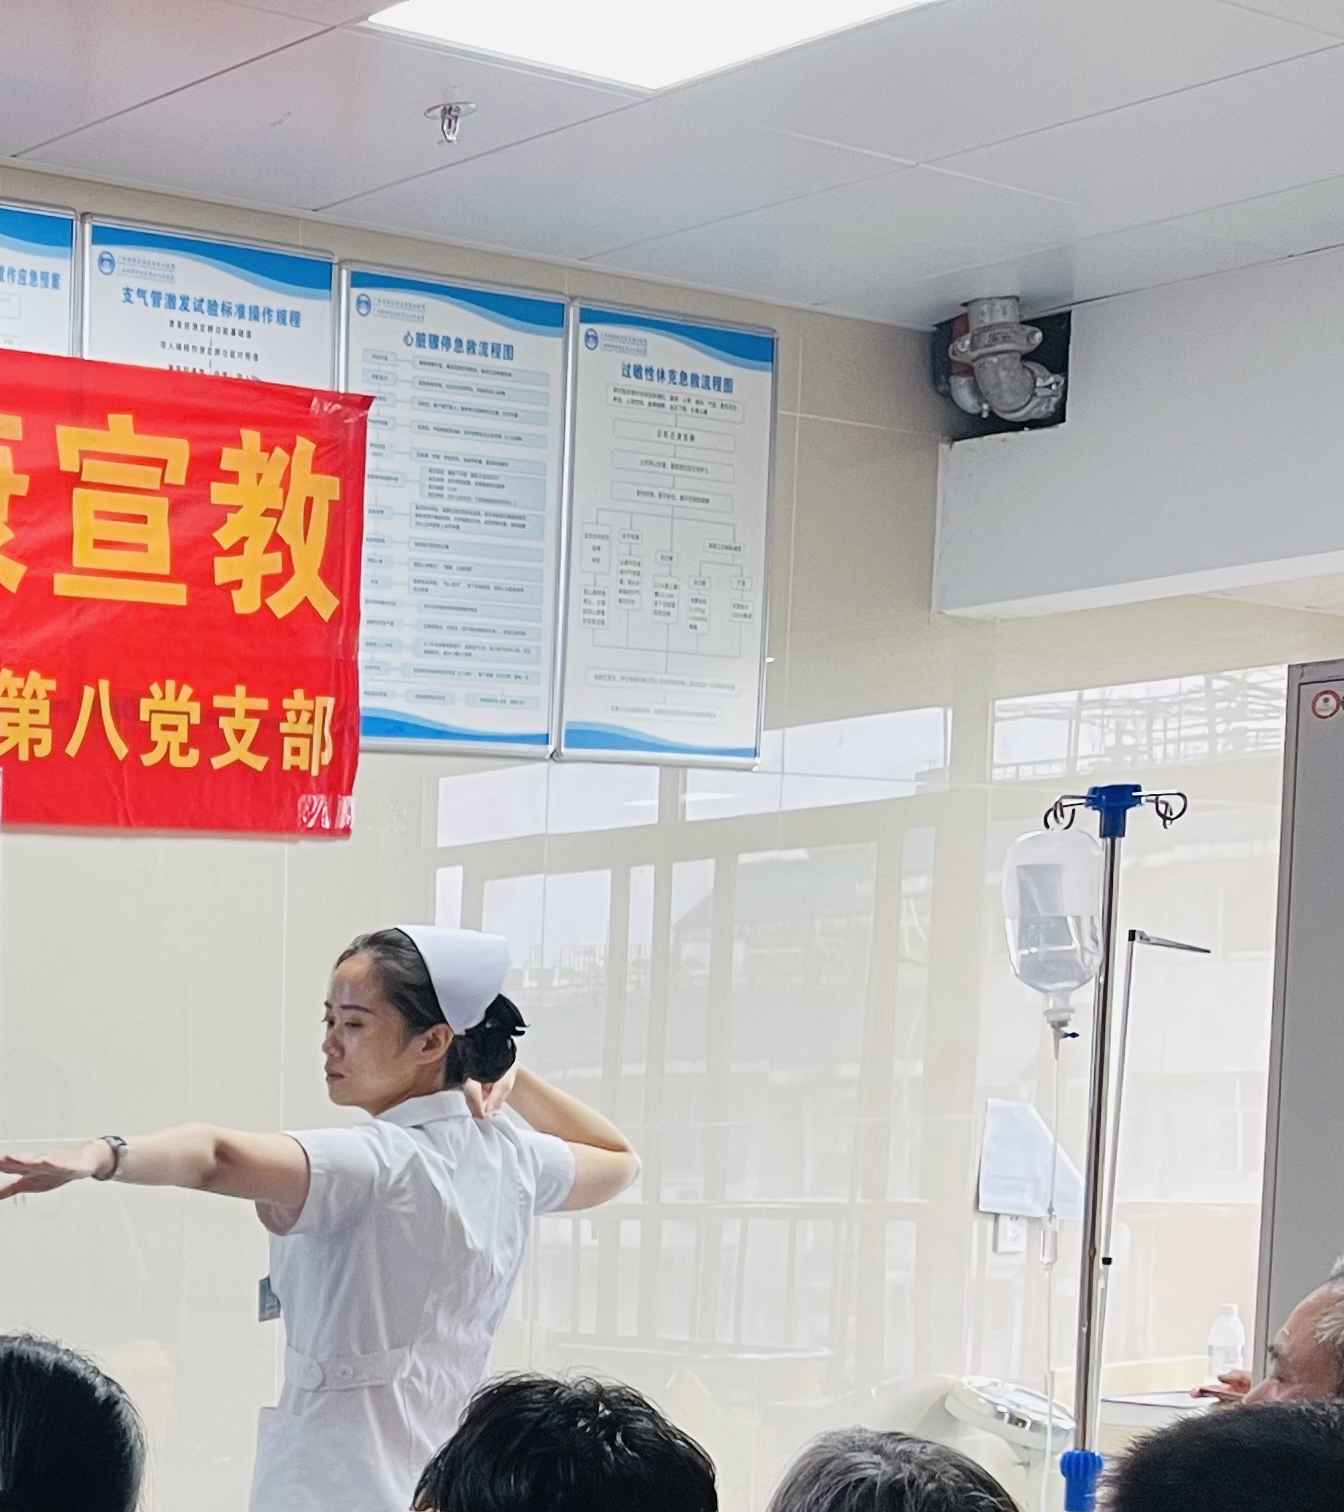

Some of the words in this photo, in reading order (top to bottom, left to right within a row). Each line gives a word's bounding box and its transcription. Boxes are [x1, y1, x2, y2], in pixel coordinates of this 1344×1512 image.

[122, 286, 302, 328] 支气管激发试验标准操作规程
[403, 331, 515, 361] 心脏骤停急救流程图
[621, 361, 734, 395] 过敏性休克急救流程图
